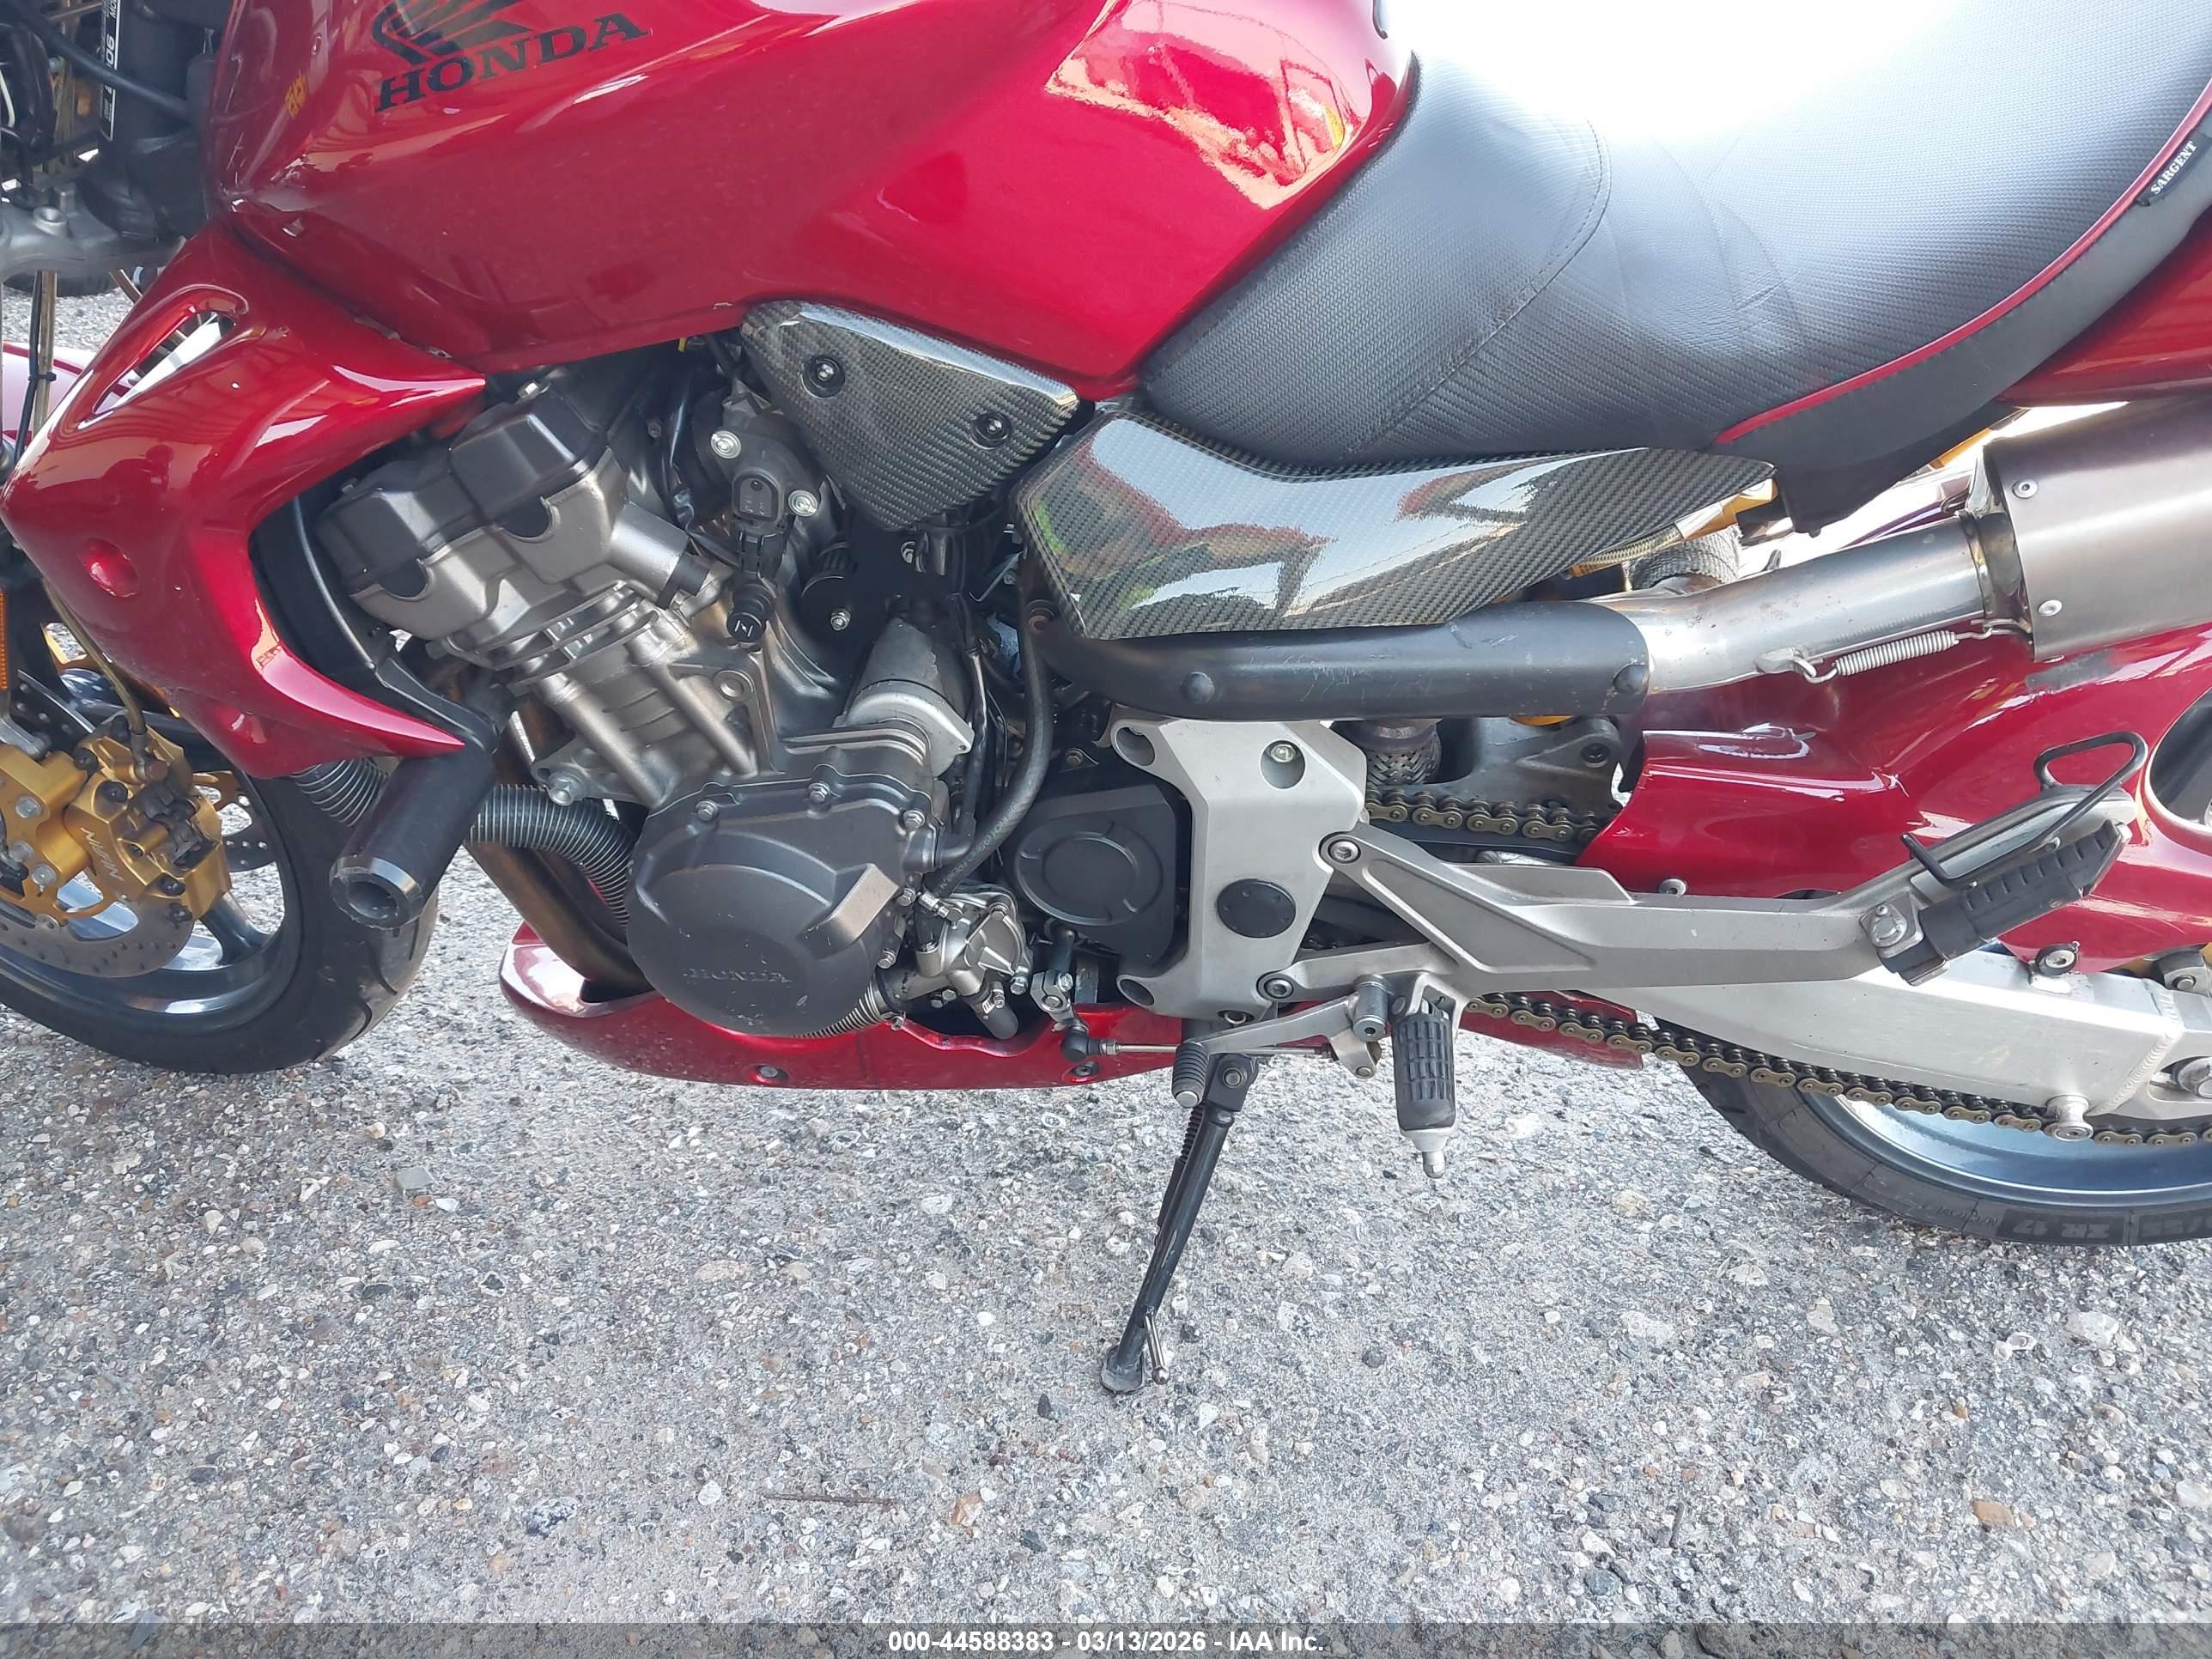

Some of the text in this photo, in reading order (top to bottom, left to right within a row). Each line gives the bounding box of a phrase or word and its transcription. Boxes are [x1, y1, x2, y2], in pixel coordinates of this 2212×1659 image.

[375, 12, 653, 112] HONDA
[2150, 140, 2197, 195] SARGENT
[682, 968, 793, 983] HONDA
[2013, 1218, 2048, 1236] 17
[2061, 1223, 2110, 1239] ZR
